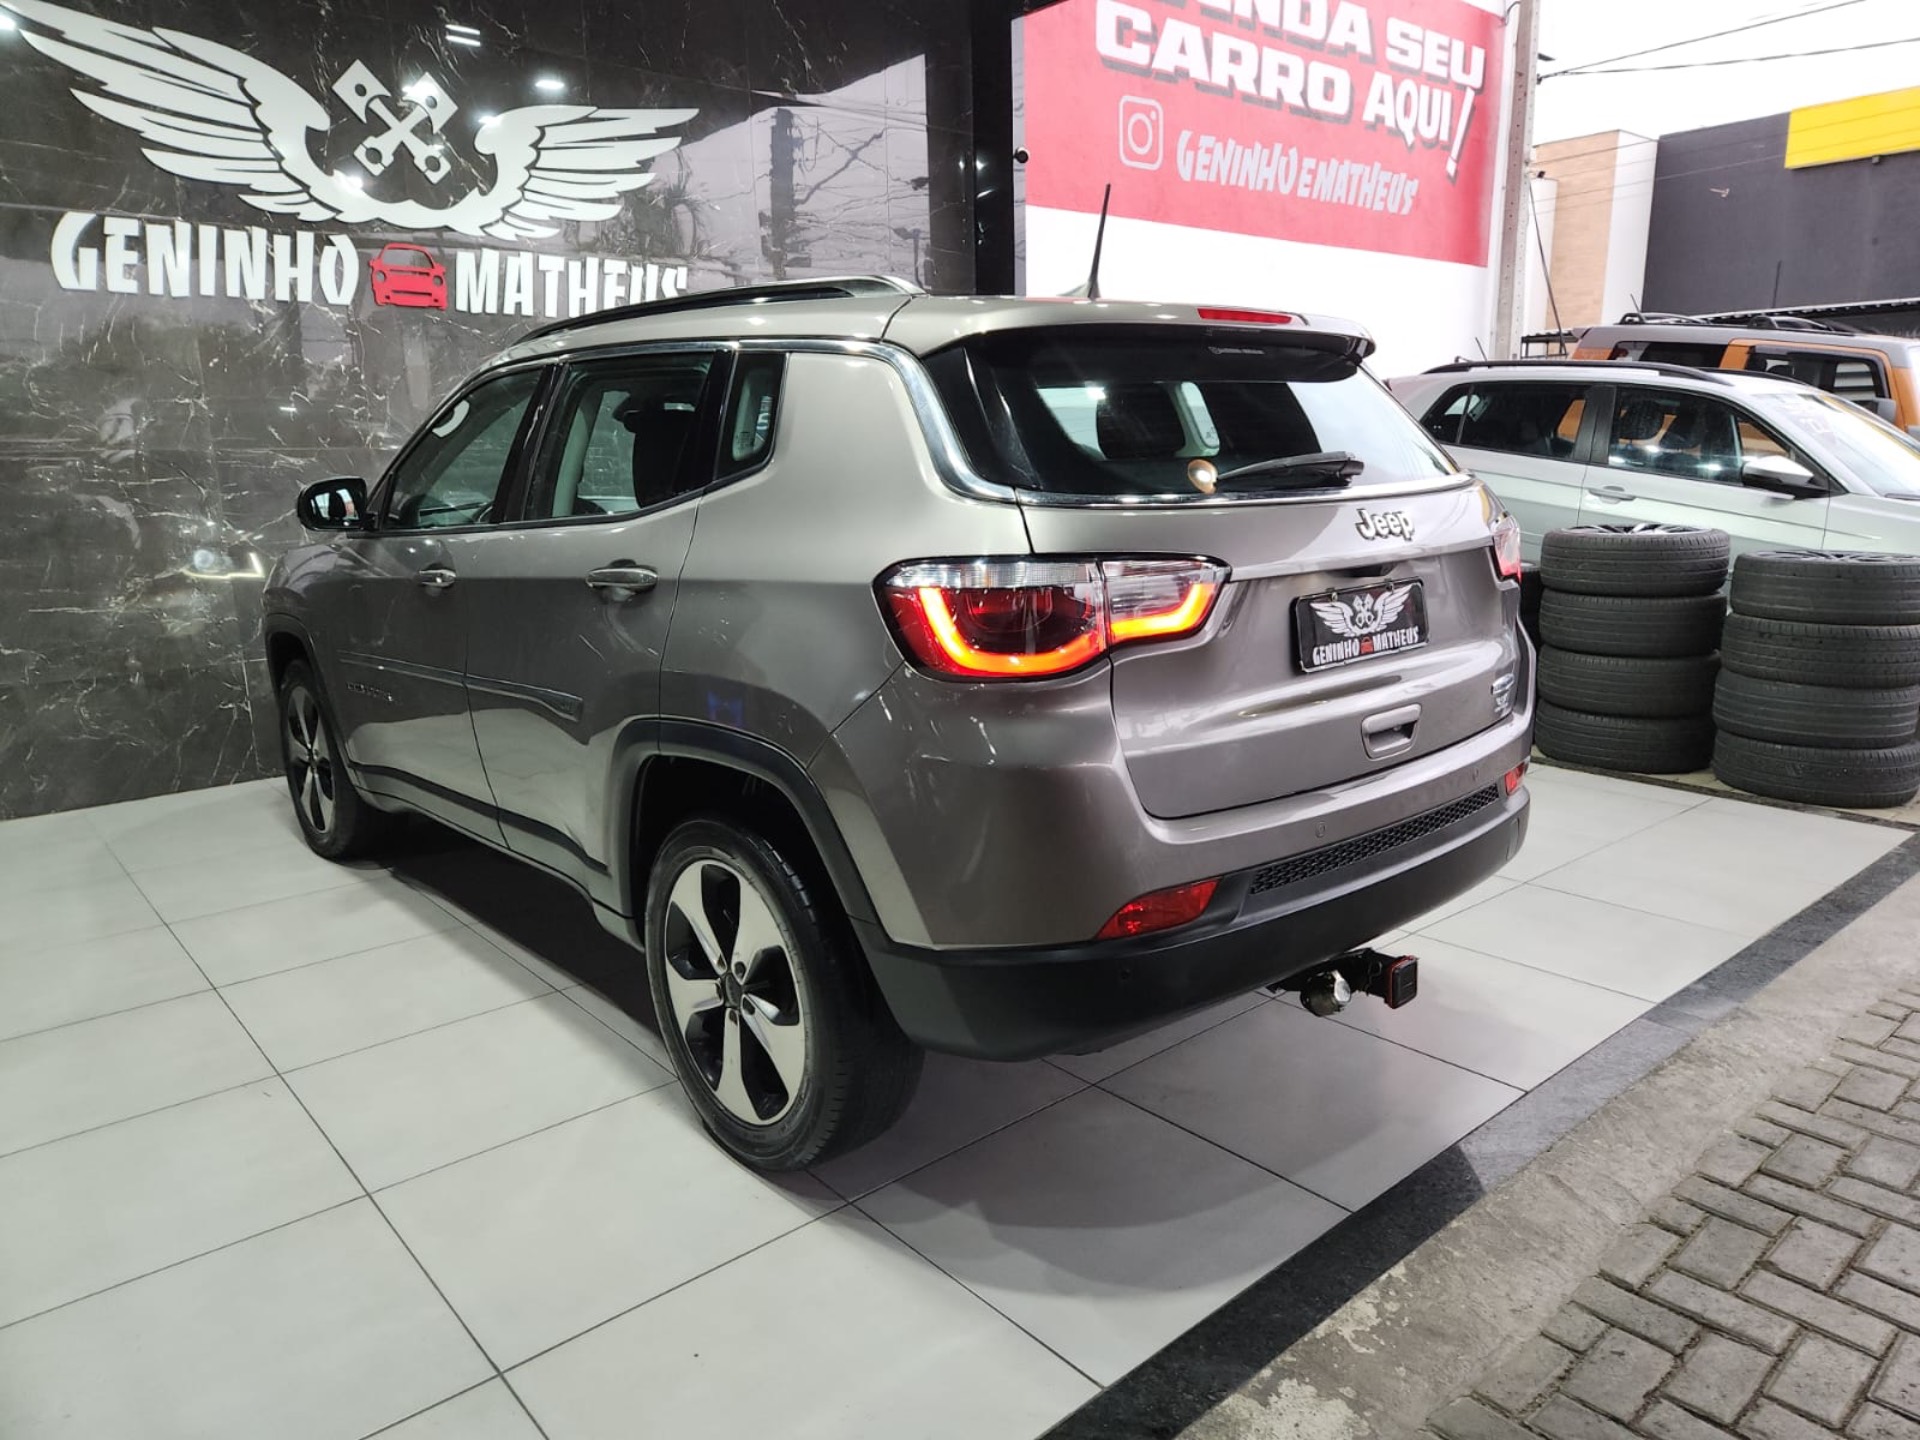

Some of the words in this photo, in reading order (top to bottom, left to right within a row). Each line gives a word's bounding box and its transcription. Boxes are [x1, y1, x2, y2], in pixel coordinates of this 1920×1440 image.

[1096, 0, 1352, 117] CARRO
[1385, 16, 1486, 90] SEU
[51, 211, 359, 306] GENINHO
[1355, 508, 1415, 541] Jeep
[1312, 637, 1360, 666] GENINHO
[1372, 625, 1419, 652] MATHEUS
